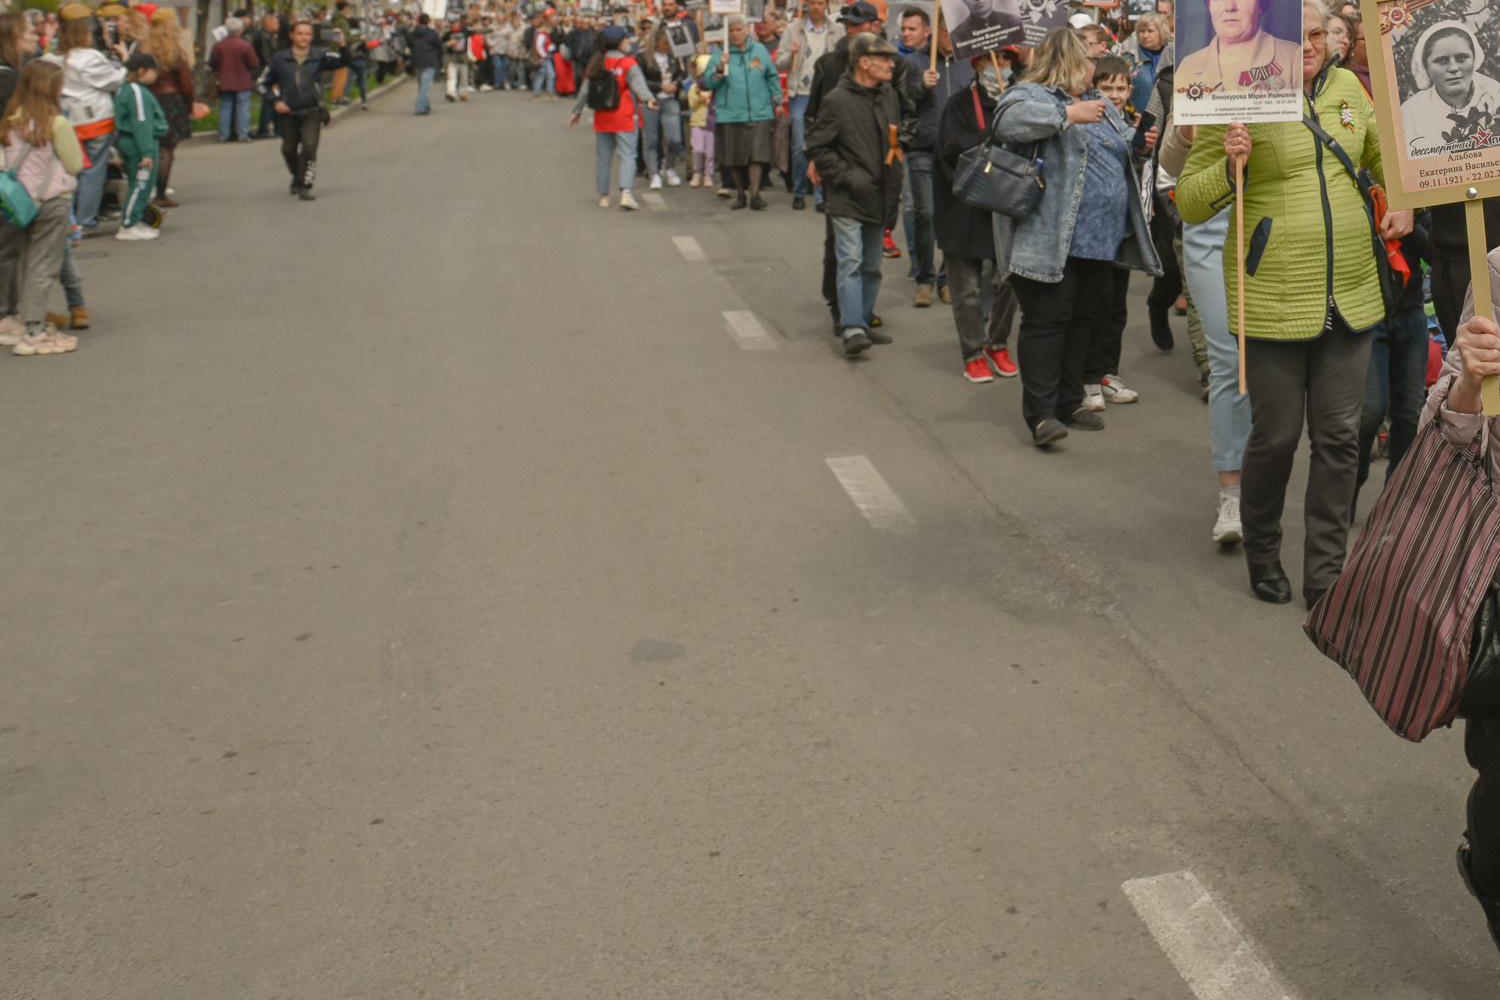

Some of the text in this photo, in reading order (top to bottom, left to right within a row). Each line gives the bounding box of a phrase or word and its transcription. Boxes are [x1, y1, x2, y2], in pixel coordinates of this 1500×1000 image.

[1211, 93, 1247, 101] Винокурова
[1447, 151, 1483, 162] Альбова
[1419, 166, 1463, 178] Екатерина
[1419, 176, 1464, 189] 09.11.1921
